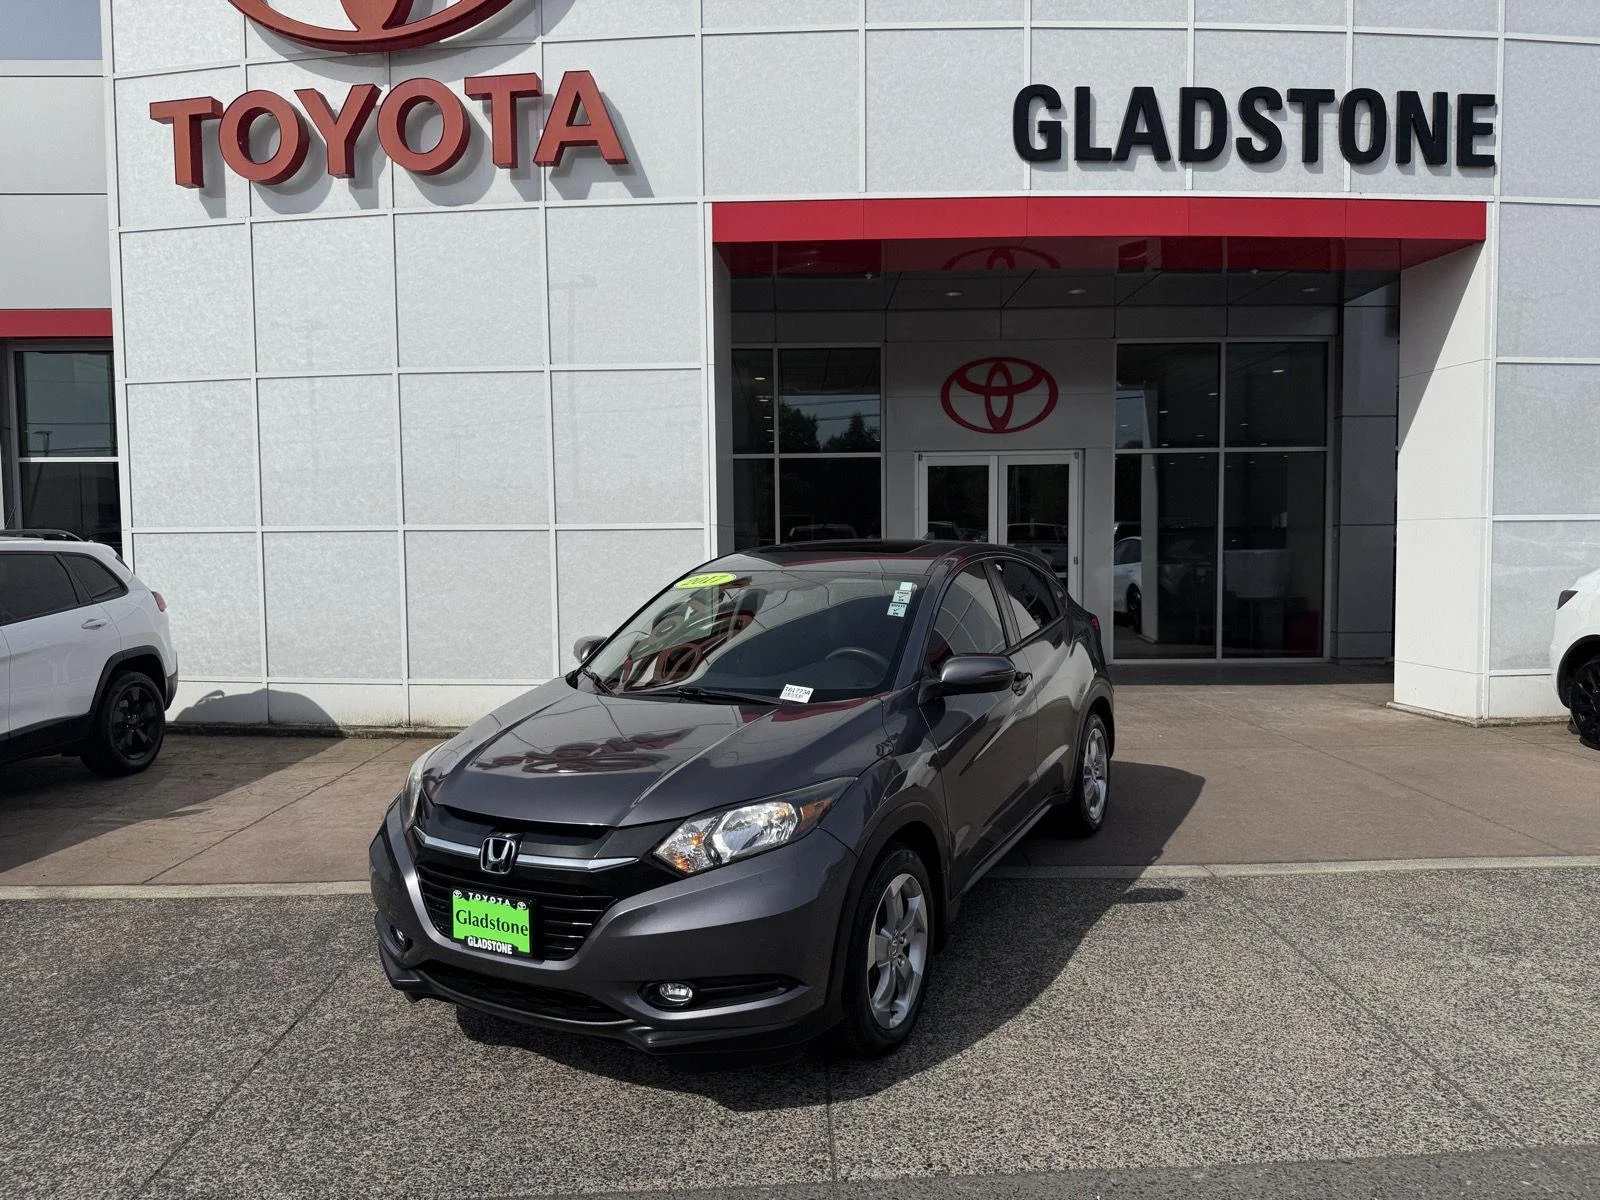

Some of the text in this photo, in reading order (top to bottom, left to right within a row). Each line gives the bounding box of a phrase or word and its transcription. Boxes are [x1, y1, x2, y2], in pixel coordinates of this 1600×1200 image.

[149, 70, 629, 189] TOYOTA
[1013, 83, 1496, 167] GLADSTONE
[468, 892, 511, 906] TOYOTA
[455, 909, 528, 936] Gladstone
[467, 936, 513, 955] GLADSTONE
